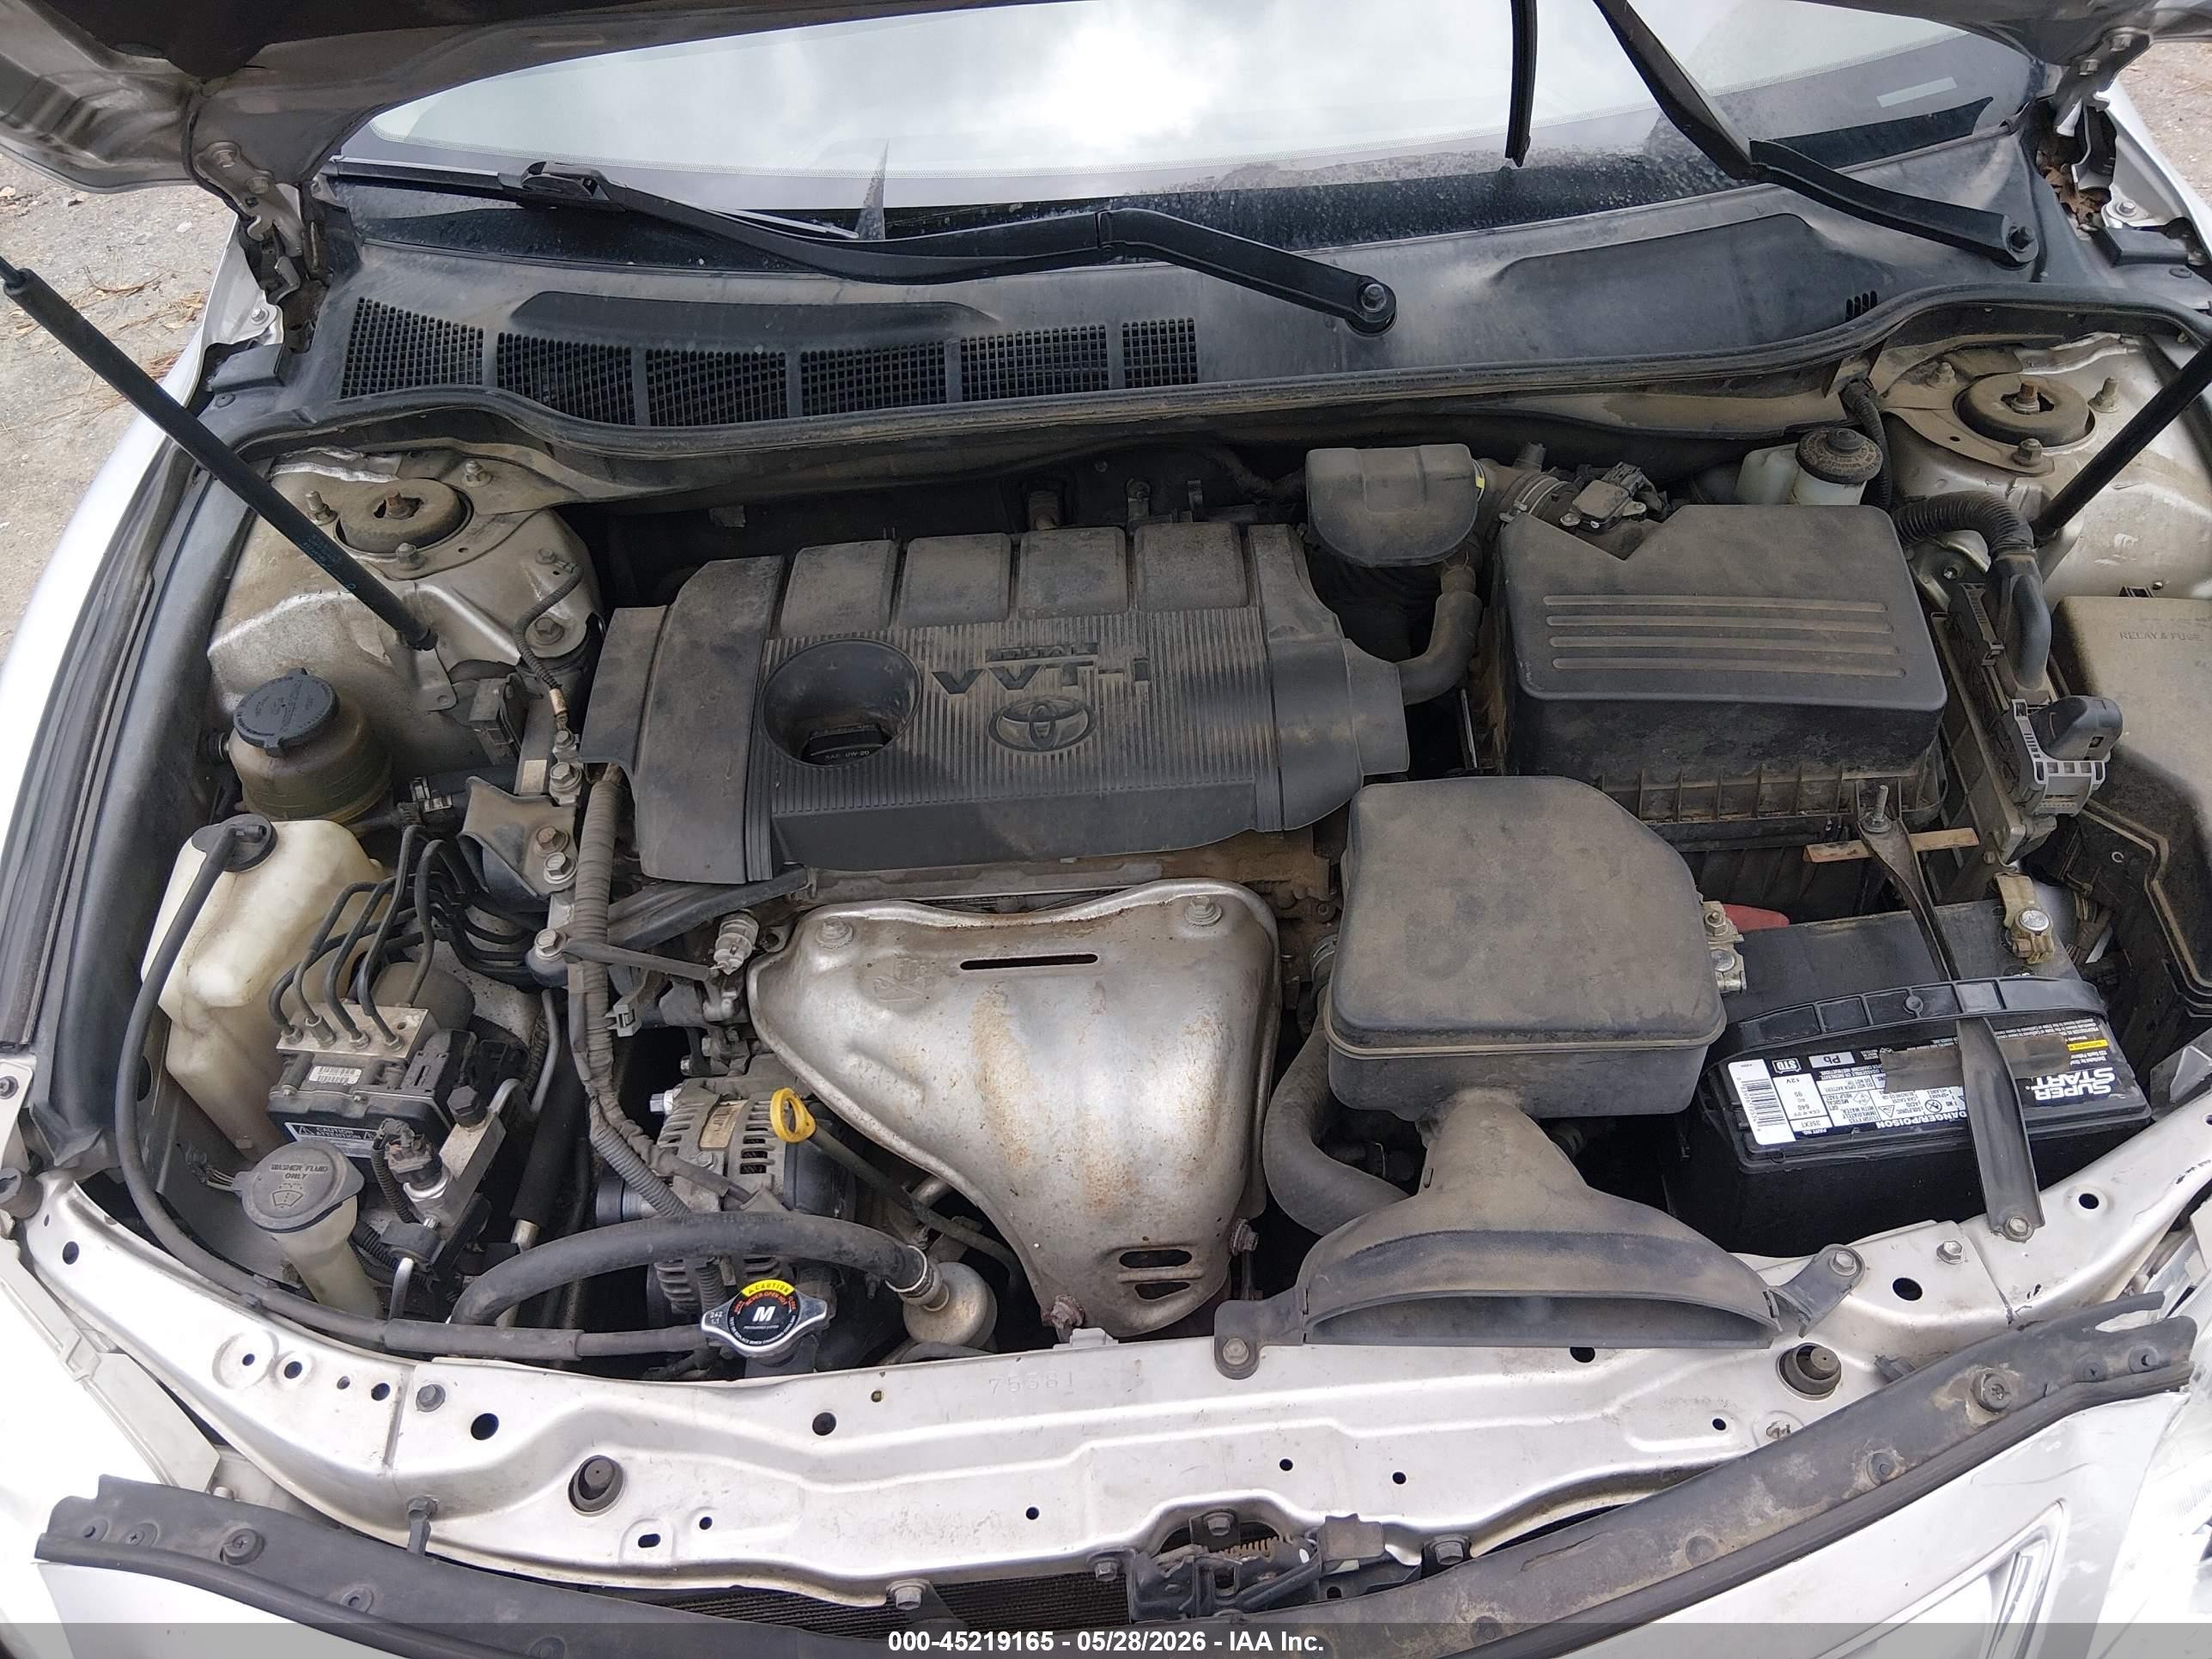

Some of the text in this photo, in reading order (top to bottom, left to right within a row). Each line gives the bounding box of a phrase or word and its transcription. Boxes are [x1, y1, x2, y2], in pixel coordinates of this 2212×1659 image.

[1776, 1060, 1796, 1070] STD
[1823, 1055, 1841, 1064] Pb
[2031, 1066, 2116, 1091] START
[2034, 1080, 2112, 1101] SUPER
[1876, 1110, 1967, 1128] DANGER/POISON
[315, 1131, 362, 1139] ATTENTION
[755, 1282, 789, 1293] CAUTION
